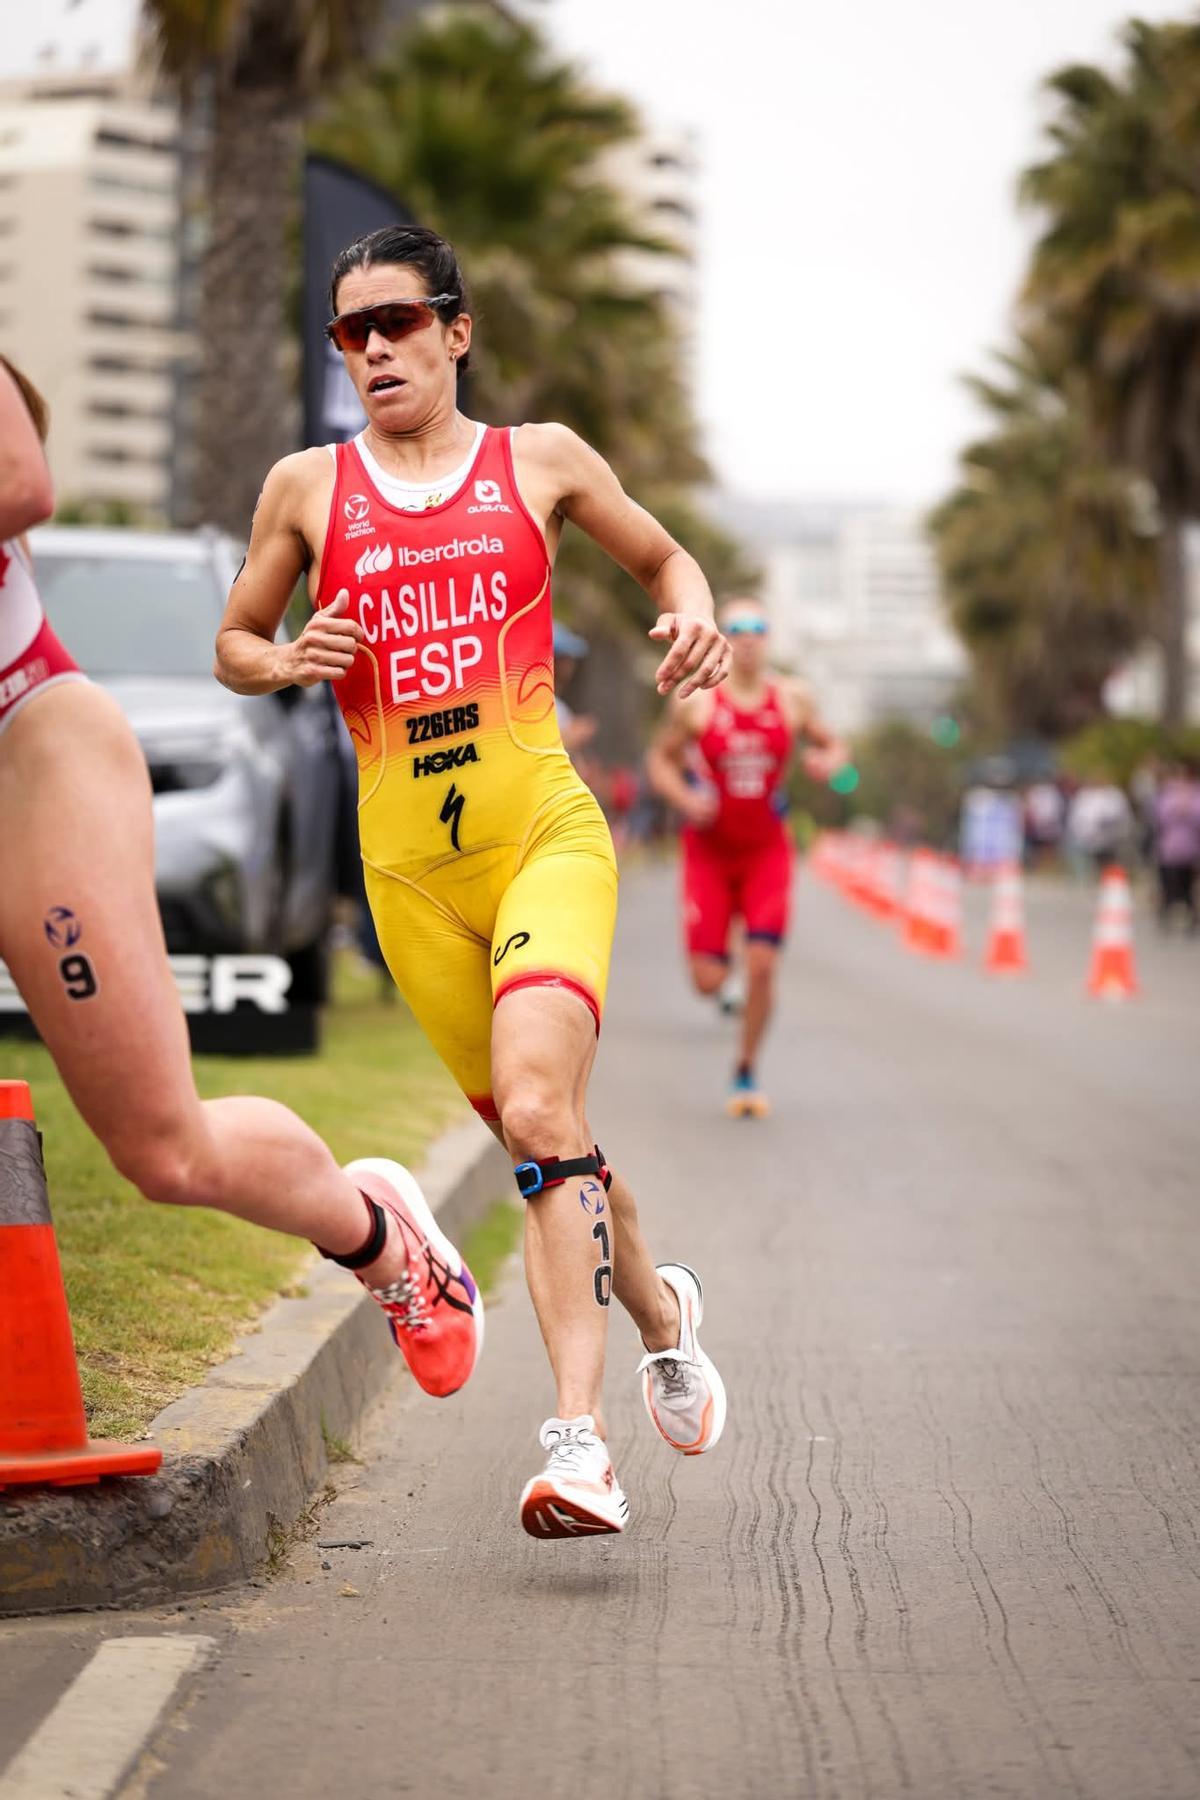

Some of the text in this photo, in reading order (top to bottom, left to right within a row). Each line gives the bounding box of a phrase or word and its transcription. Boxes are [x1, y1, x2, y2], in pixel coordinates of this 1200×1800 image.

[398, 534, 504, 567] Iberdrola
[358, 570, 508, 644] CASILLAS
[390, 635, 483, 704] ESP
[406, 703, 479, 744] 226ERS
[413, 743, 481, 778] HOKA
[60, 954, 96, 1000] 9
